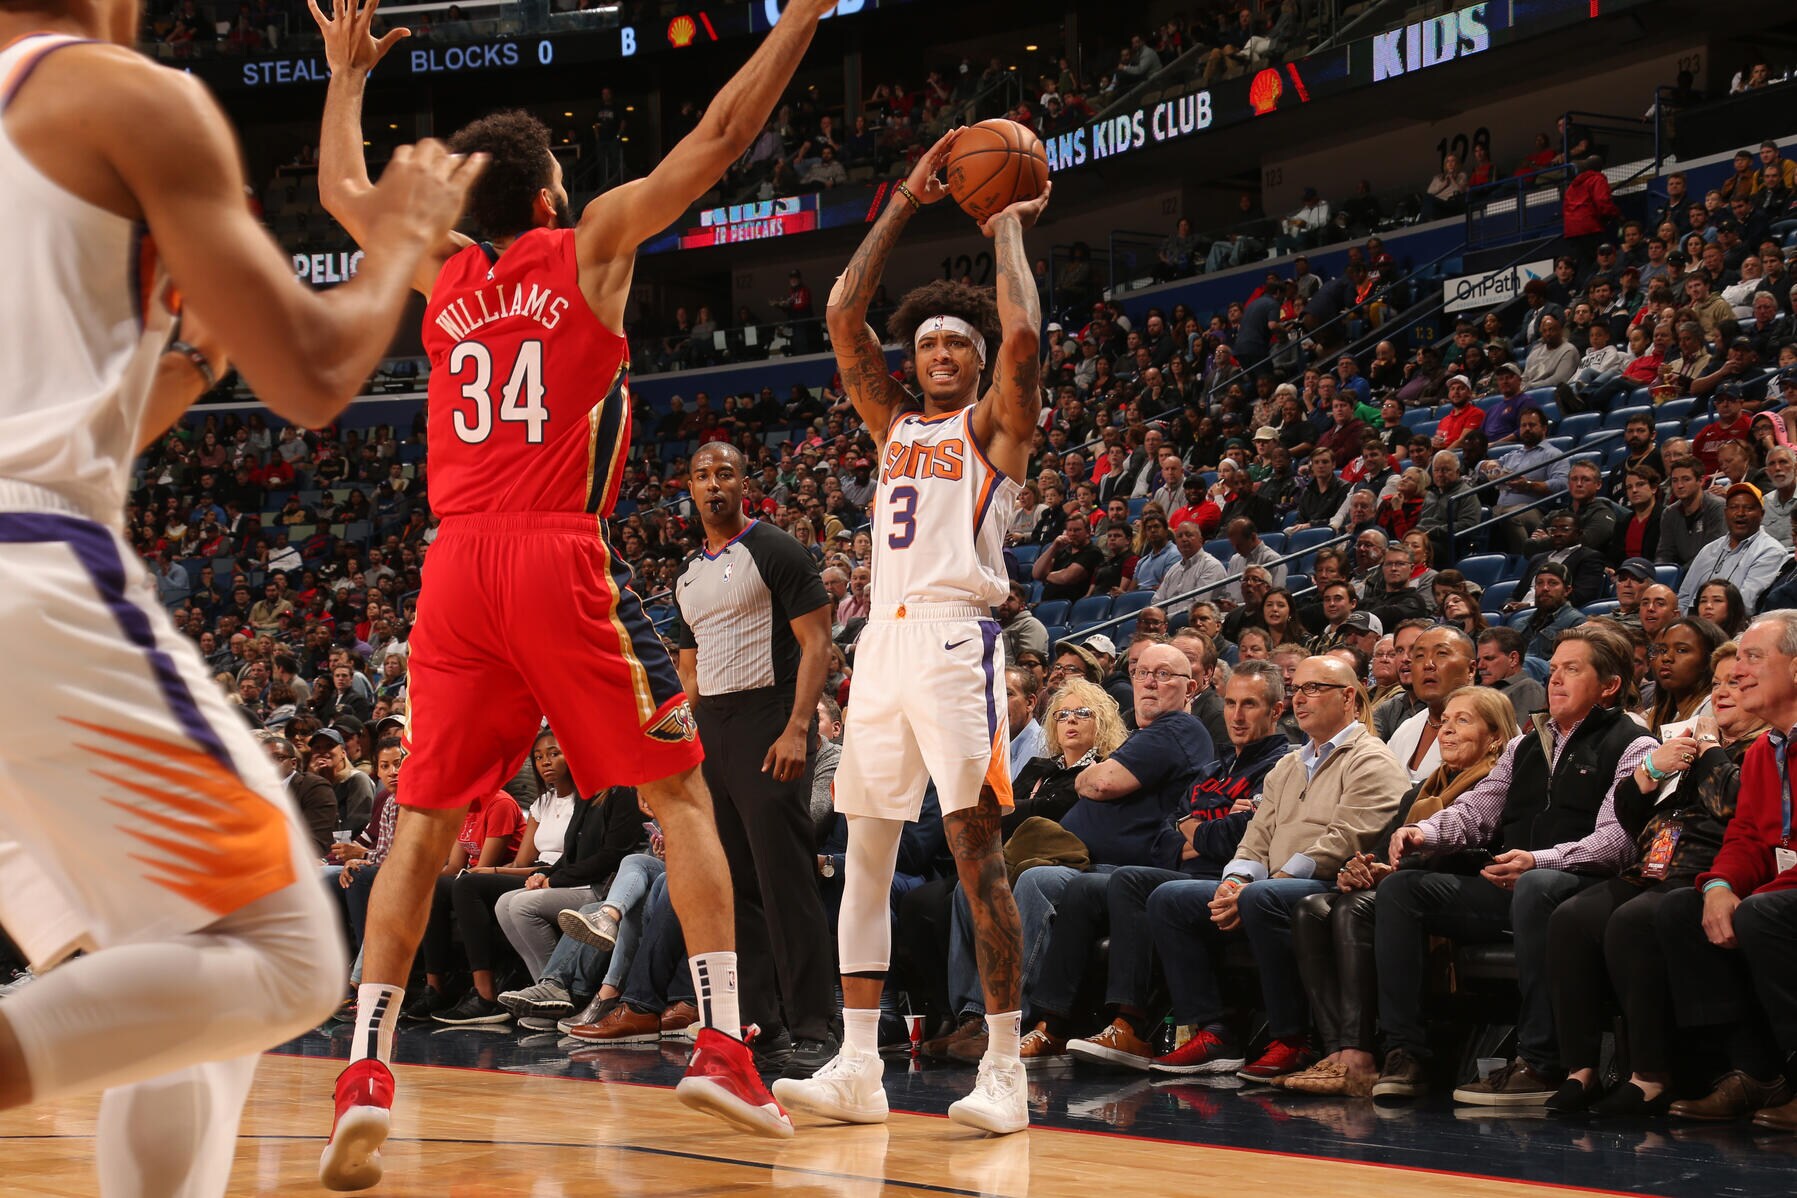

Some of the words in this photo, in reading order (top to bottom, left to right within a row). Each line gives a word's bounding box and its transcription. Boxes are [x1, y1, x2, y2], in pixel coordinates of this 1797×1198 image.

[411, 43, 519, 72] BLOCKS
[537, 40, 553, 65] 0
[621, 26, 637, 56] B
[1373, 2, 1489, 82] KIDS
[1093, 109, 1146, 160] KIDS
[1152, 90, 1213, 142] CLUB
[730, 218, 783, 243] PELICANS
[435, 282, 569, 342] WILLIAMS
[1457, 271, 1521, 300] OnPath
[449, 339, 550, 444] 34
[888, 485, 919, 551] 3
